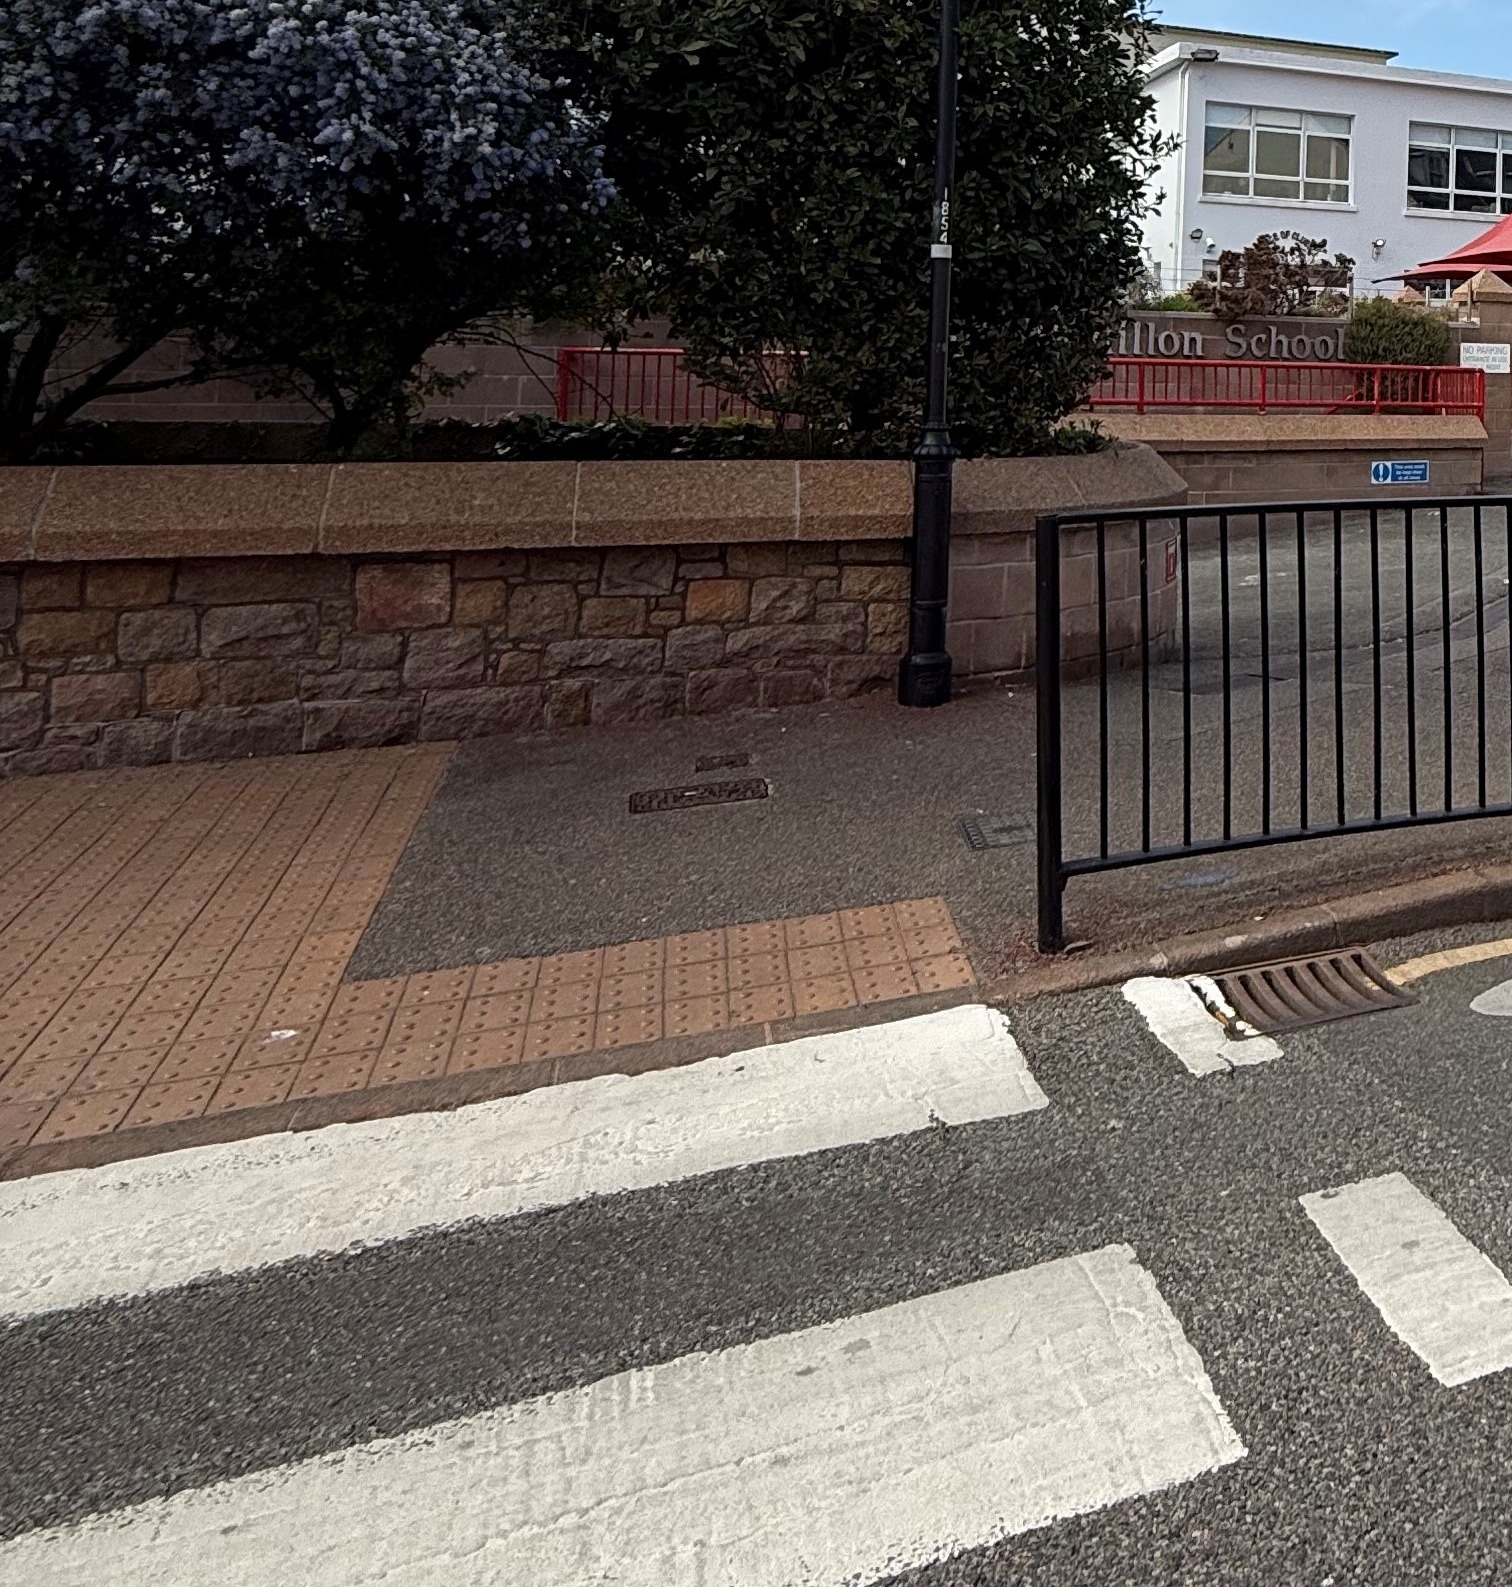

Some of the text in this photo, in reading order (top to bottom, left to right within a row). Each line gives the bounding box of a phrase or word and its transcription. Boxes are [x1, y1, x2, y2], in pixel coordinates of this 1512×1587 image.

[939, 187, 950, 244] 1854
[1224, 323, 1347, 361] School
[1463, 346, 1508, 355] NO PARKING
